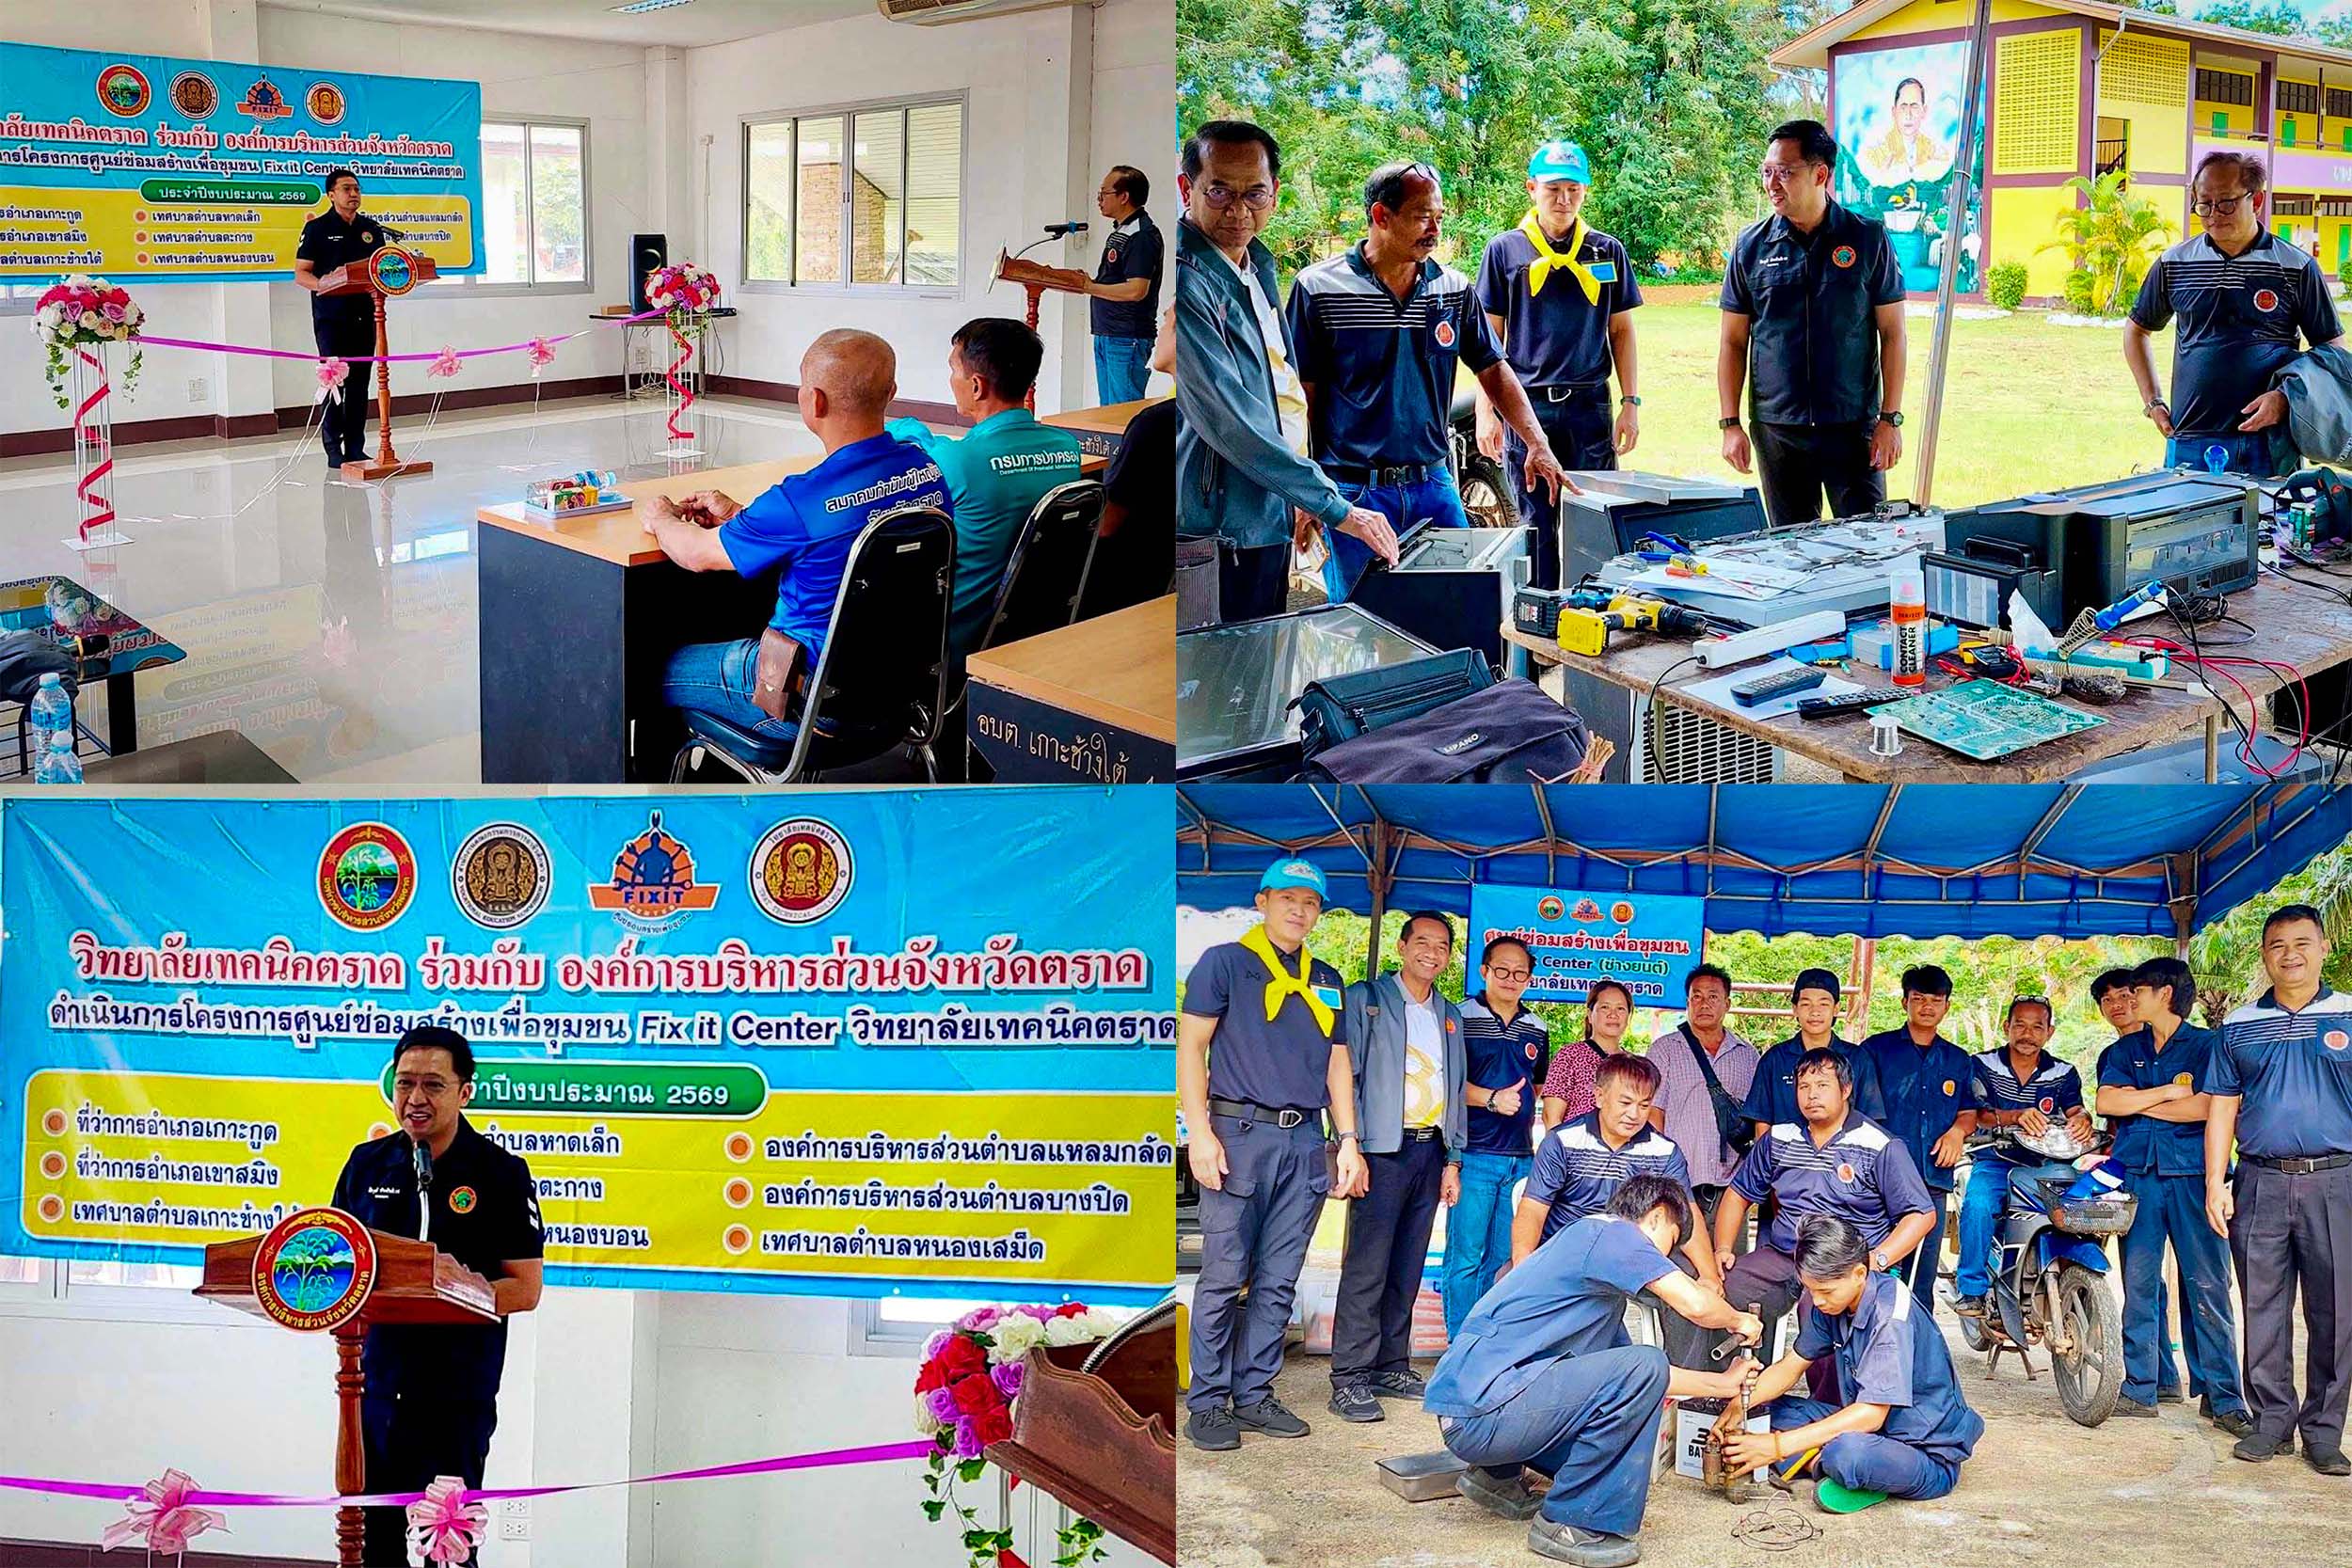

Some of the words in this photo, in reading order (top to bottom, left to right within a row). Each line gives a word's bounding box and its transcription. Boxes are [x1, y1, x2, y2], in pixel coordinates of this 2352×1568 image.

[156, 123, 216, 147] ร่วมกับ
[226, 128, 452, 155] องค์การบริหารส่วนจังหวัดตราด
[264, 161, 282, 172] Fix
[291, 162, 298, 173] it
[352, 161, 462, 177] วิทยาลัยเทคนิคตราด
[159, 186, 274, 200] ประจำปีงบประมาณ
[278, 191, 307, 200] 2569
[152, 210, 261, 222] เทศบาลตำบลหาดเล็ก
[153, 230, 252, 243] เทศบาลตำบลตะกาง
[154, 251, 275, 263] เทศบาลตำบลหนองบอน
[1908, 626, 1916, 673] CLEANER
[977, 714, 1022, 749] อบต.
[625, 891, 684, 903] FIXIT
[75, 933, 402, 986] วิทยาลัยเทคนิคตราด
[421, 935, 540, 987] ร่วมกับ
[564, 937, 1143, 987] องค์การบริหารส่วนจังหวัดตราด
[1543, 956, 1593, 970] Center
[51, 998, 628, 1049] ดำเนินการโครงการศูนย์ซ่อมสร้างเพื่อชุมชน
[643, 1015, 687, 1039] Fix
[691, 1016, 716, 1040] it
[731, 1017, 837, 1041] Center
[852, 1009, 1176, 1040] วิทยาลัยเทคนิคตราด
[667, 1085, 729, 1106] 2569
[76, 1103, 277, 1149] ที่ว่าการอำเภอเกาะกูด
[766, 1132, 1173, 1165] องค์การบริหารส่วนตำบลแหลมกลัด
[76, 1152, 279, 1186] ที่ว่าการอำเภอเขาสมิง
[765, 1178, 1129, 1212] องค์การบริหารส่วนตำบลบางปิด
[762, 1227, 1044, 1260] เทศบาลตำบลหนองเสม็ด
